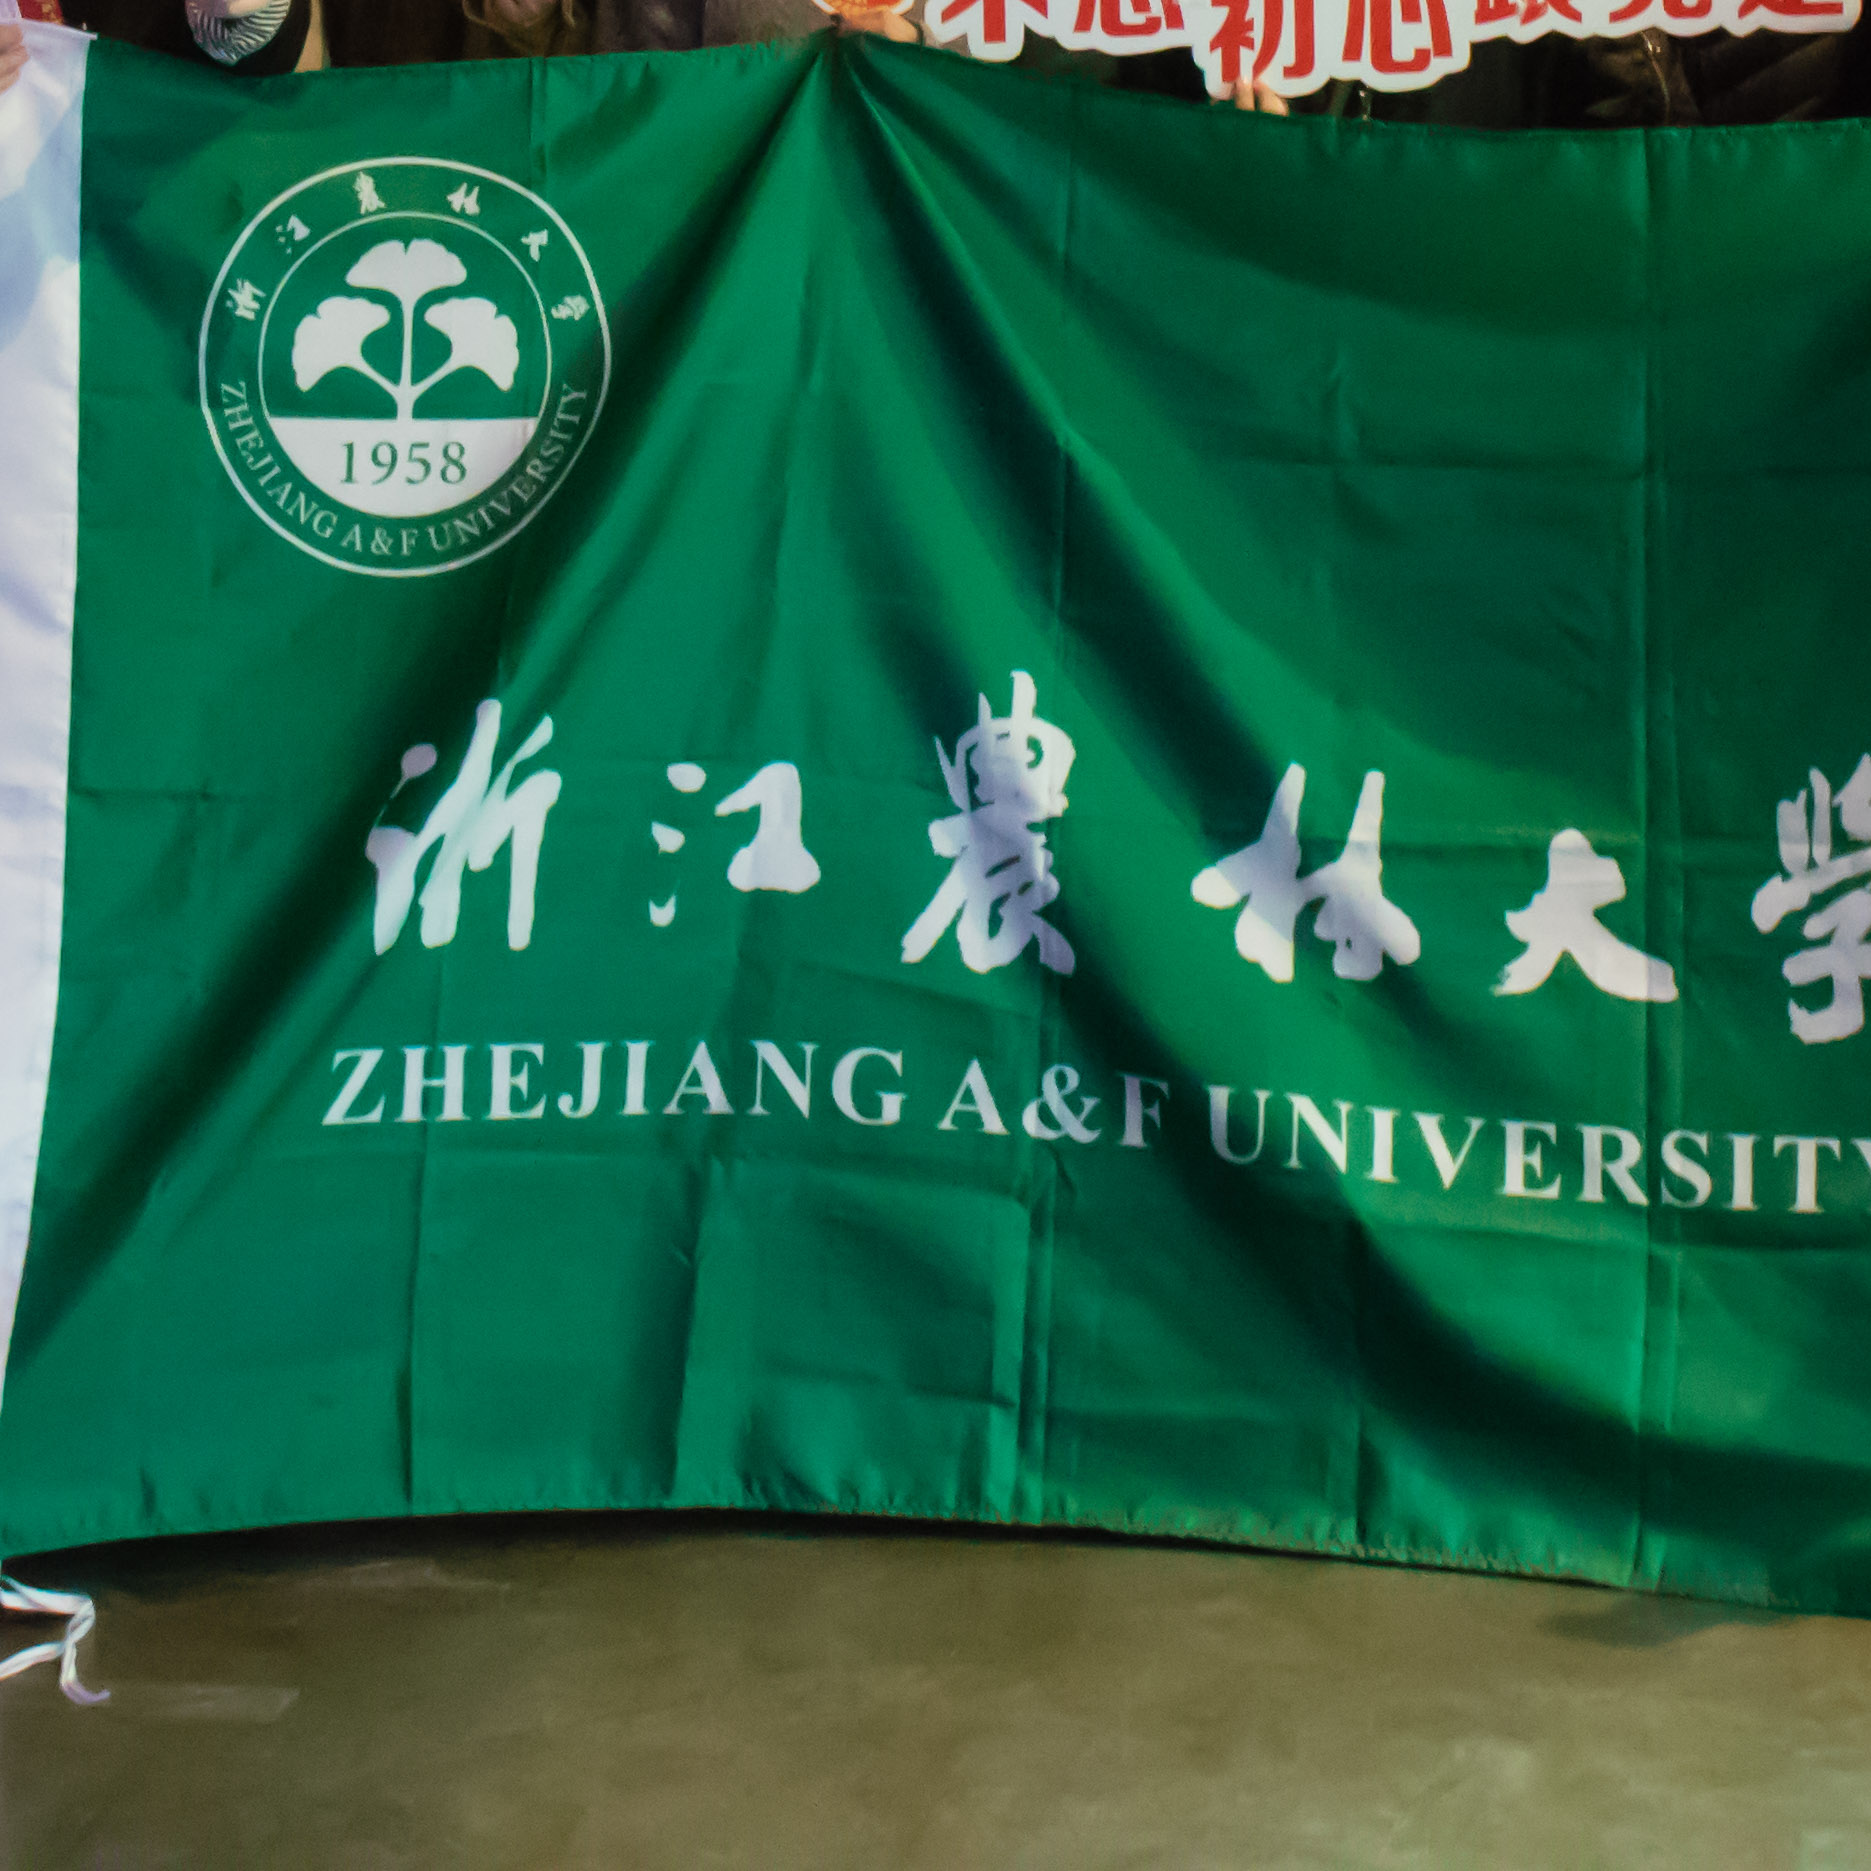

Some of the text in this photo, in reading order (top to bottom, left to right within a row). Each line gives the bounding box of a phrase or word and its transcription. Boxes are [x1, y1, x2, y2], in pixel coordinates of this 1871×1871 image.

[219, 380, 589, 556] ZHEJIANG A&F UNIVERSITY
[339, 442, 468, 485] 1958
[321, 1040, 907, 1131] ZHEJIANG
[937, 1056, 1167, 1148] A&F
